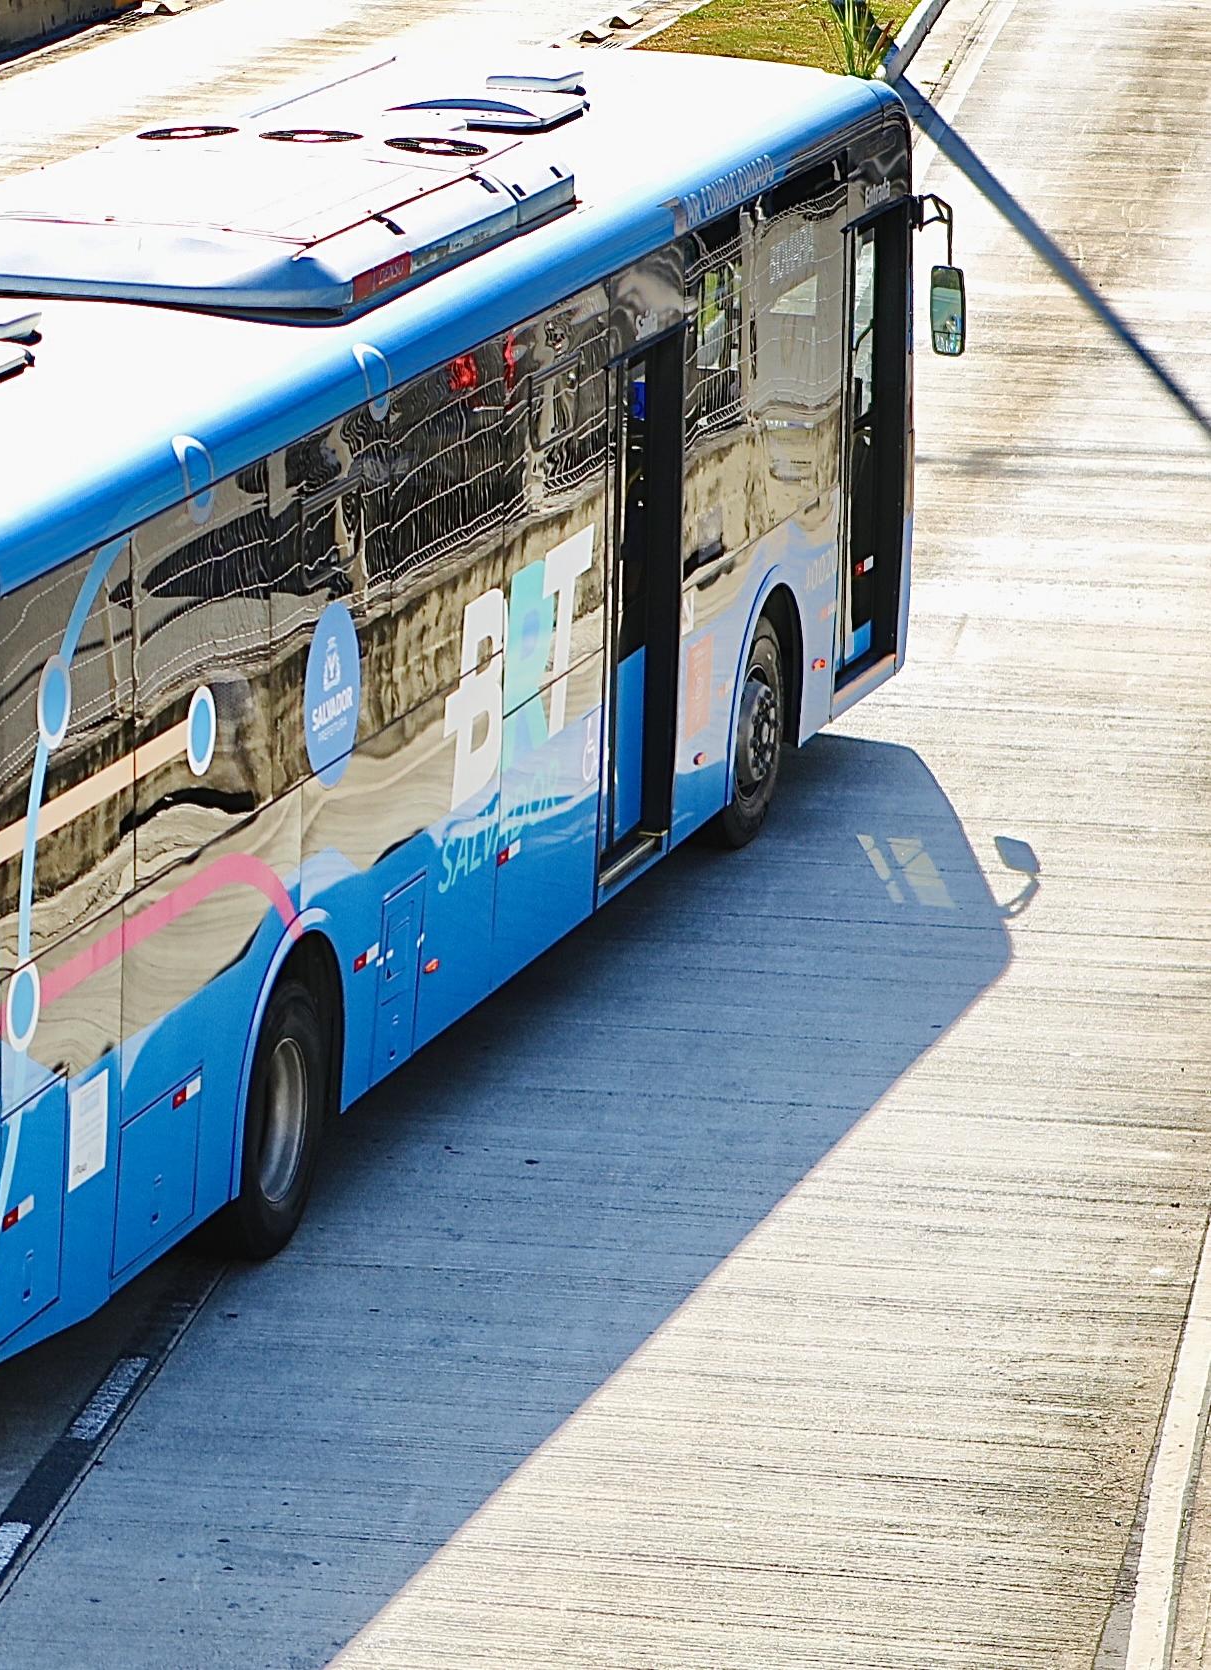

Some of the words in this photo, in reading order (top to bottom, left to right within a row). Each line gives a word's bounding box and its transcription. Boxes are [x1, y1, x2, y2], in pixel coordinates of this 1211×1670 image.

[864, 176, 890, 209] Entrada
[311, 685, 353, 731] SALVADOR
[443, 523, 594, 812] BRT
[438, 756, 560, 893] SALVADOR
